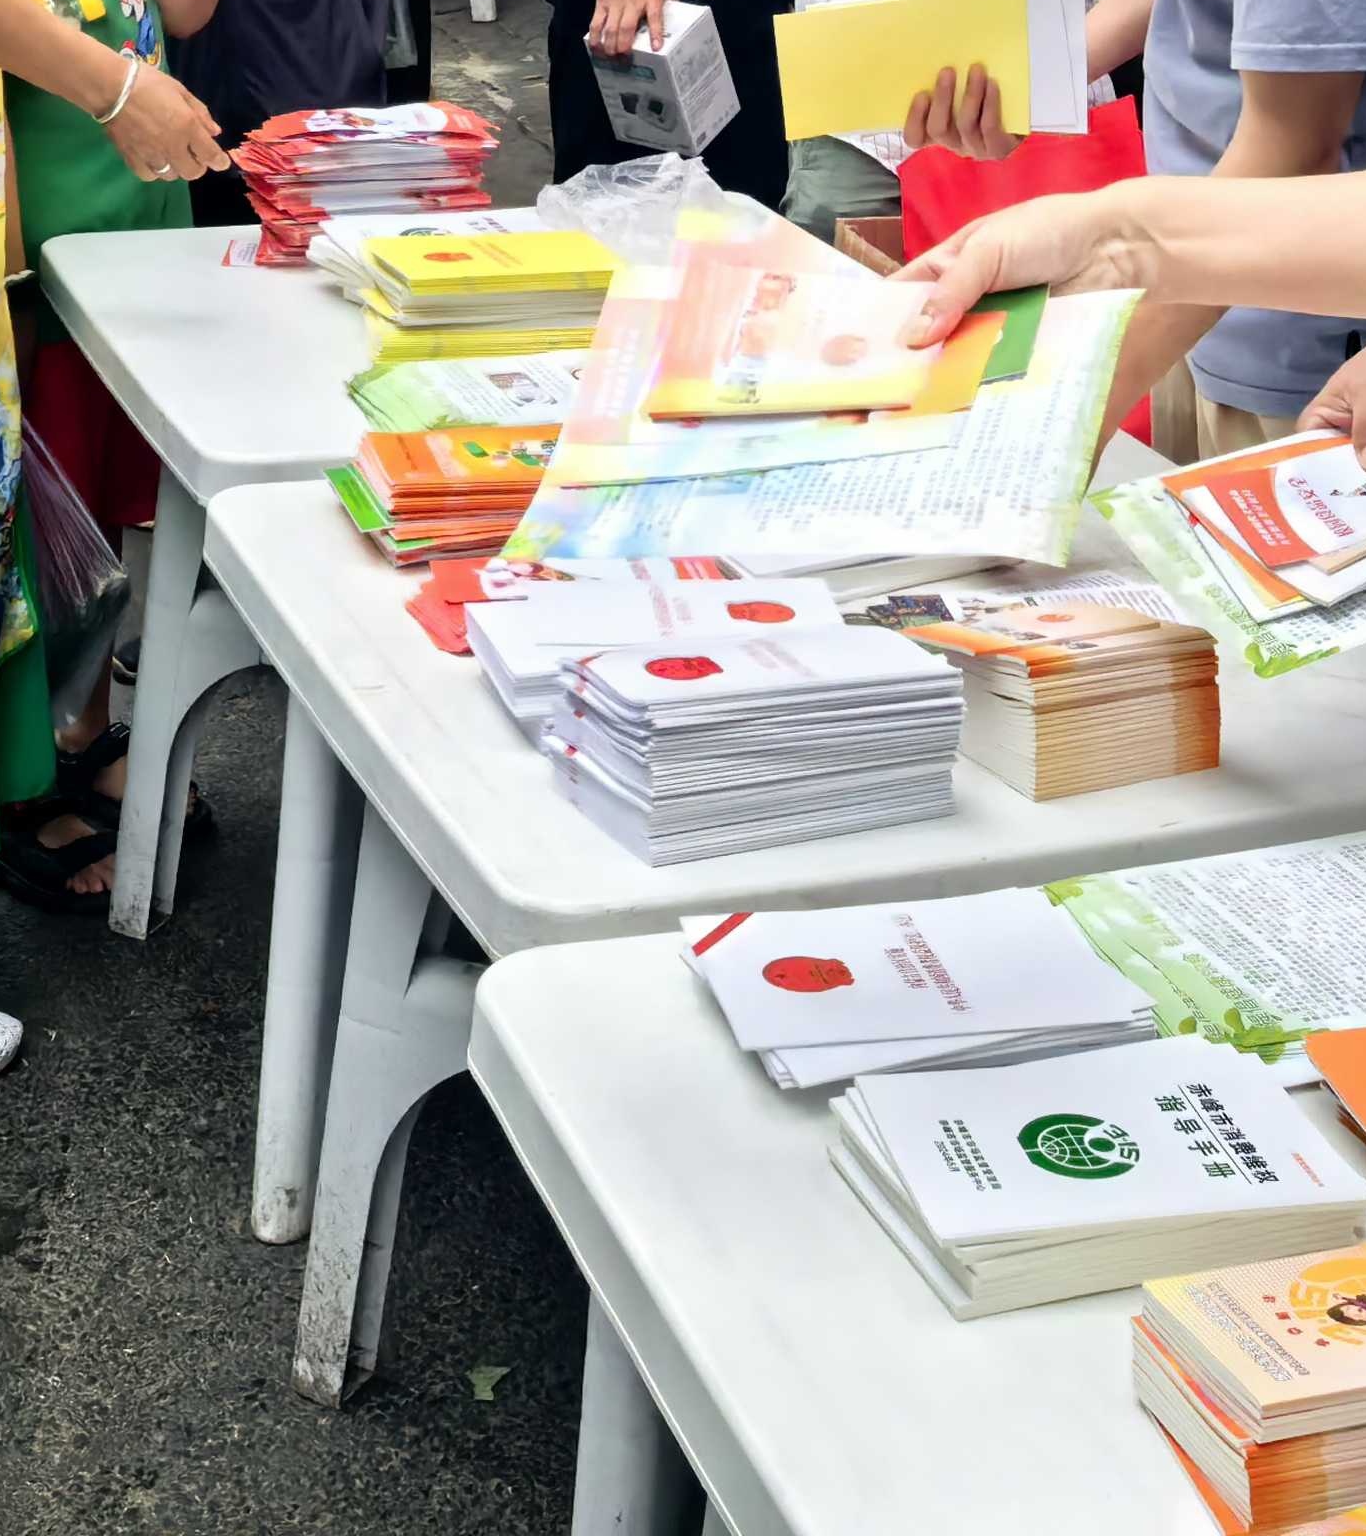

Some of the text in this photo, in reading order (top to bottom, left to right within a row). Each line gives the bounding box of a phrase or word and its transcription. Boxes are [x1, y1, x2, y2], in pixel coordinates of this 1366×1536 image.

[1154, 1094, 1236, 1179] 指导手册
[1185, 1082, 1280, 1185] 赤峰市消费维权
